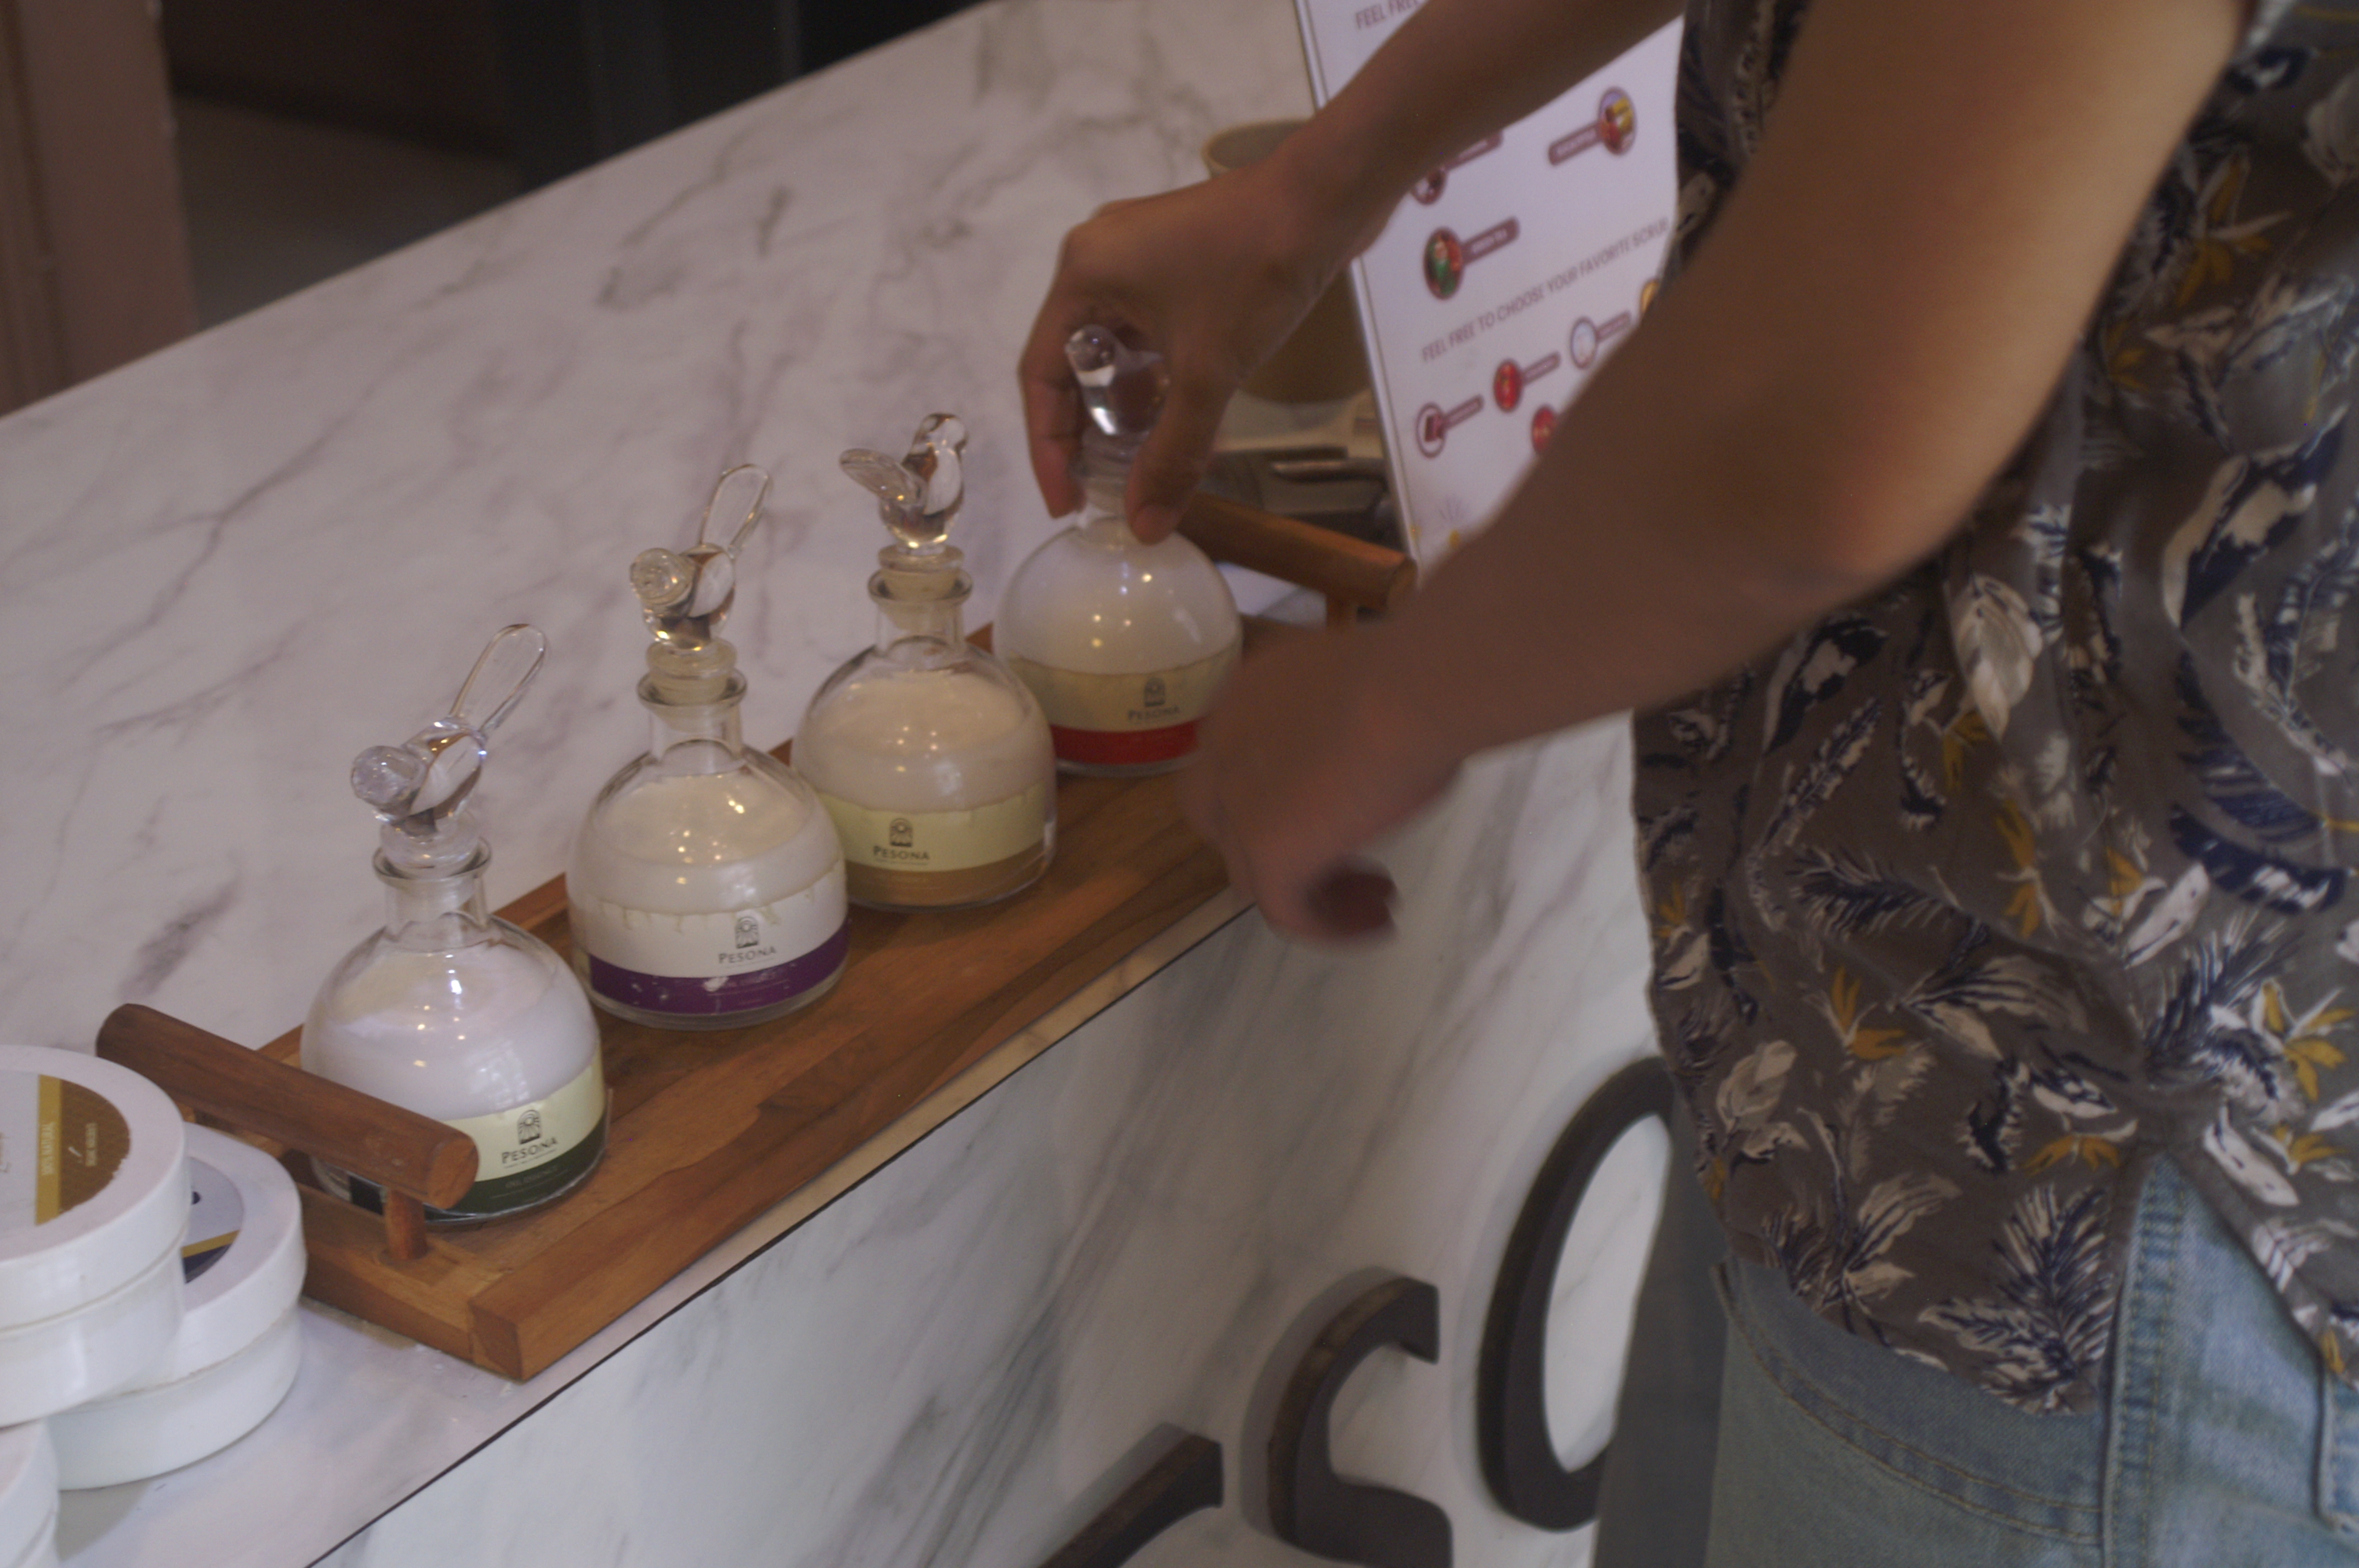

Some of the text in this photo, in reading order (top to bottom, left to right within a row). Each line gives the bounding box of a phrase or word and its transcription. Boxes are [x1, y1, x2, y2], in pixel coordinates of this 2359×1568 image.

[1355, 4, 1386, 29] FEEL
[1421, 339, 1446, 361] FEEL
[1448, 321, 1476, 347] FREE
[1478, 310, 1496, 331] TO
[1497, 285, 1544, 321] CHOOSE
[1546, 265, 1578, 292] YOUR
[1579, 235, 1630, 276] FAVORITE
[873, 845, 931, 861] PESONA
[718, 946, 777, 964] PESONA
[501, 1137, 558, 1164] PESONA
